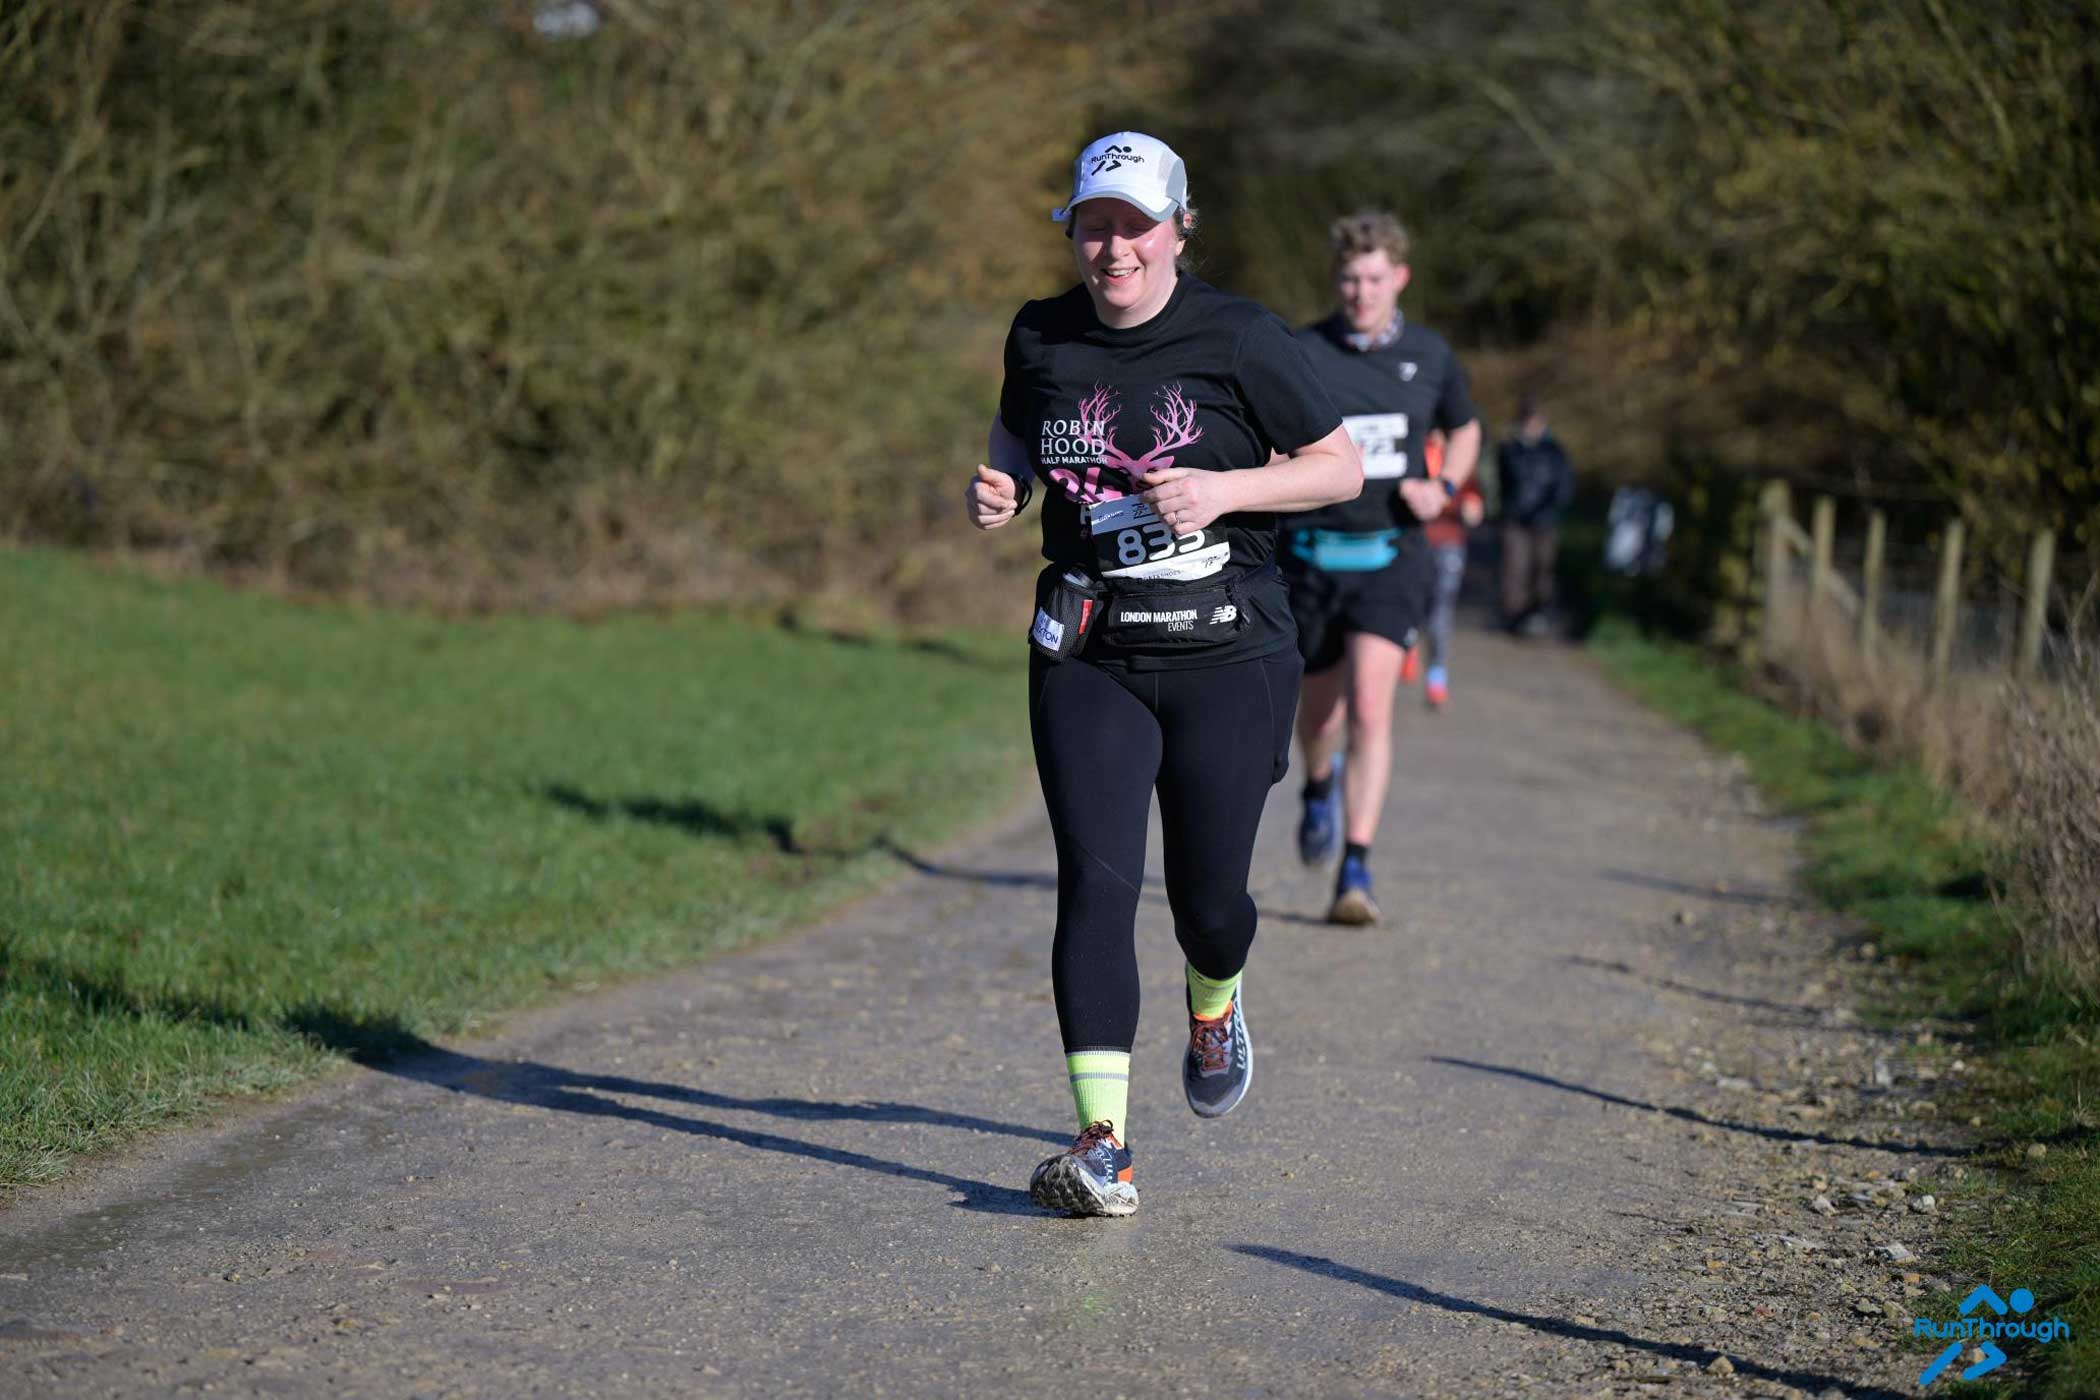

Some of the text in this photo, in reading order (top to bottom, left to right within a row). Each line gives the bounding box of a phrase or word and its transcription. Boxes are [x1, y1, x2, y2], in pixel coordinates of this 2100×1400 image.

[1091, 153, 1144, 163] RunThrough
[1041, 420, 1105, 438] ROBIN
[1041, 437, 1106, 455] HOOD
[1041, 456, 1108, 465] HALF MARATHON
[1120, 609, 1198, 623] LONDON MARATHON
[1168, 620, 1194, 632] EVENTS
